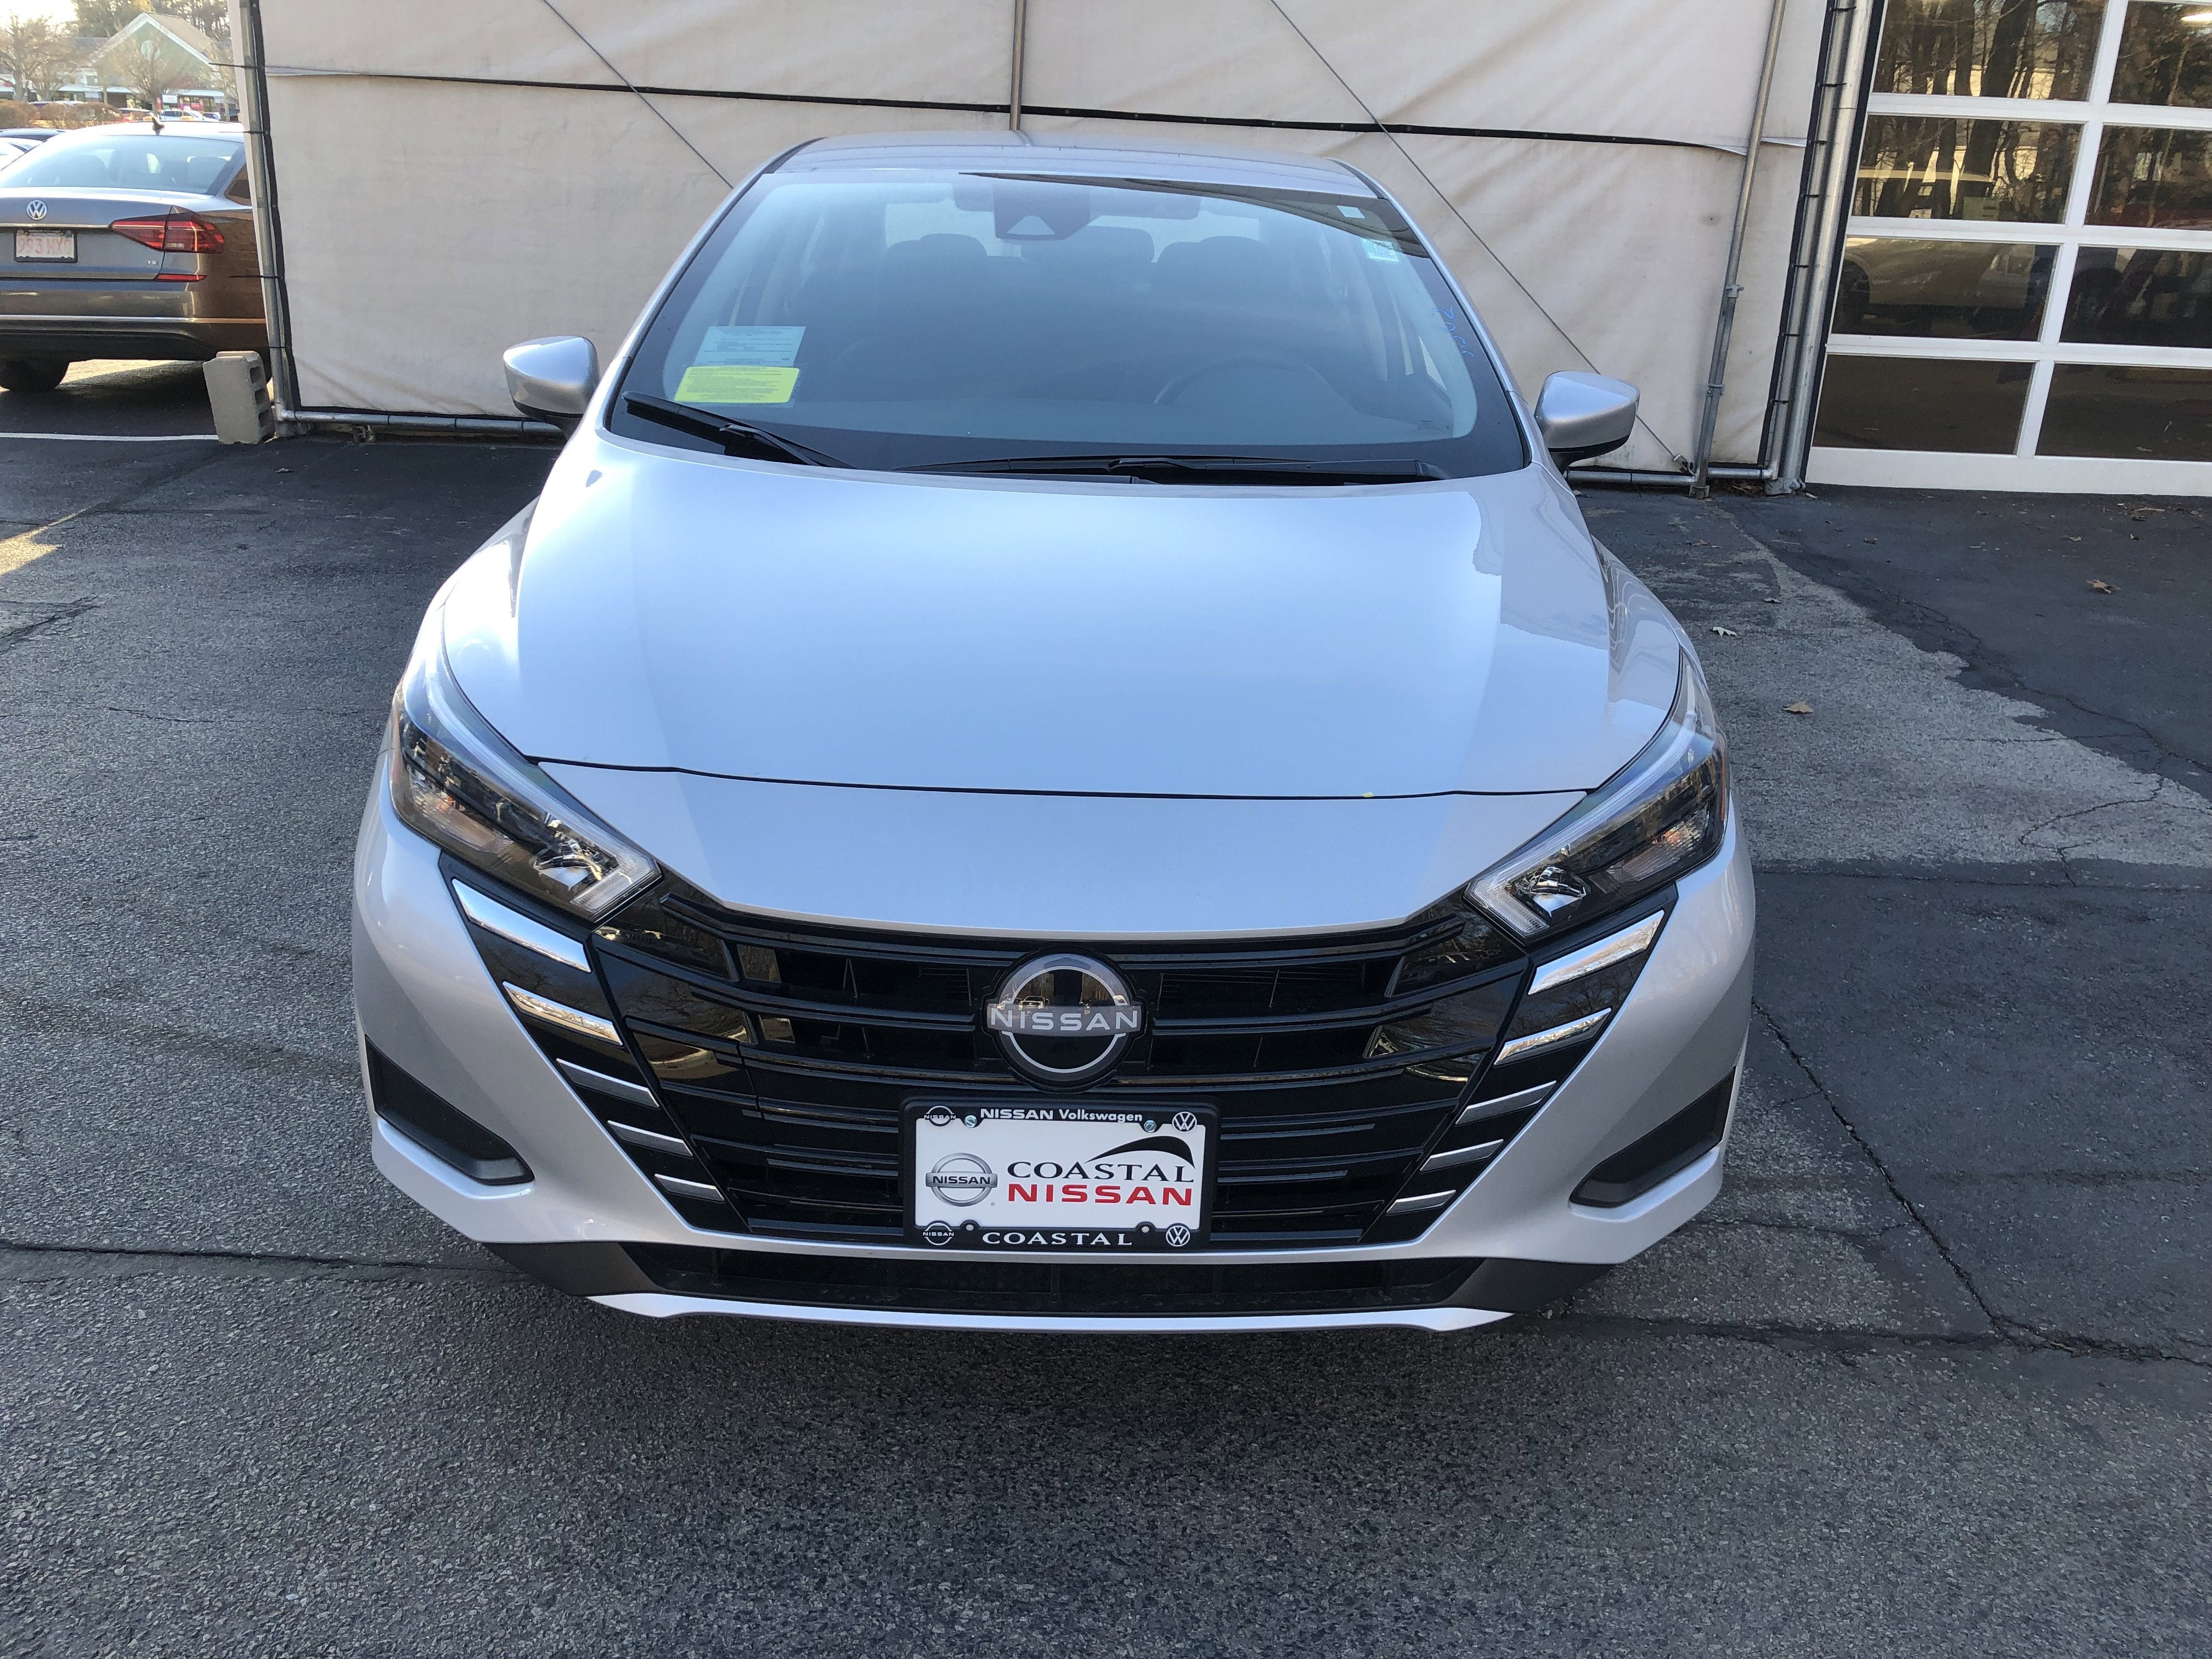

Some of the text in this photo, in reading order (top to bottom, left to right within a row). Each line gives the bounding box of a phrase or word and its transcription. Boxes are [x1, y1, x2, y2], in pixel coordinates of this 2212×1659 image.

[991, 1008, 1137, 1031] NISSAN
[980, 1108, 1142, 1123] NISSAN Volkswagen
[933, 1175, 991, 1184] NISSAN
[1007, 1161, 1194, 1183] COASTAL
[1008, 1183, 1192, 1206] NISSAN
[983, 1232, 1132, 1246] COASTAL
